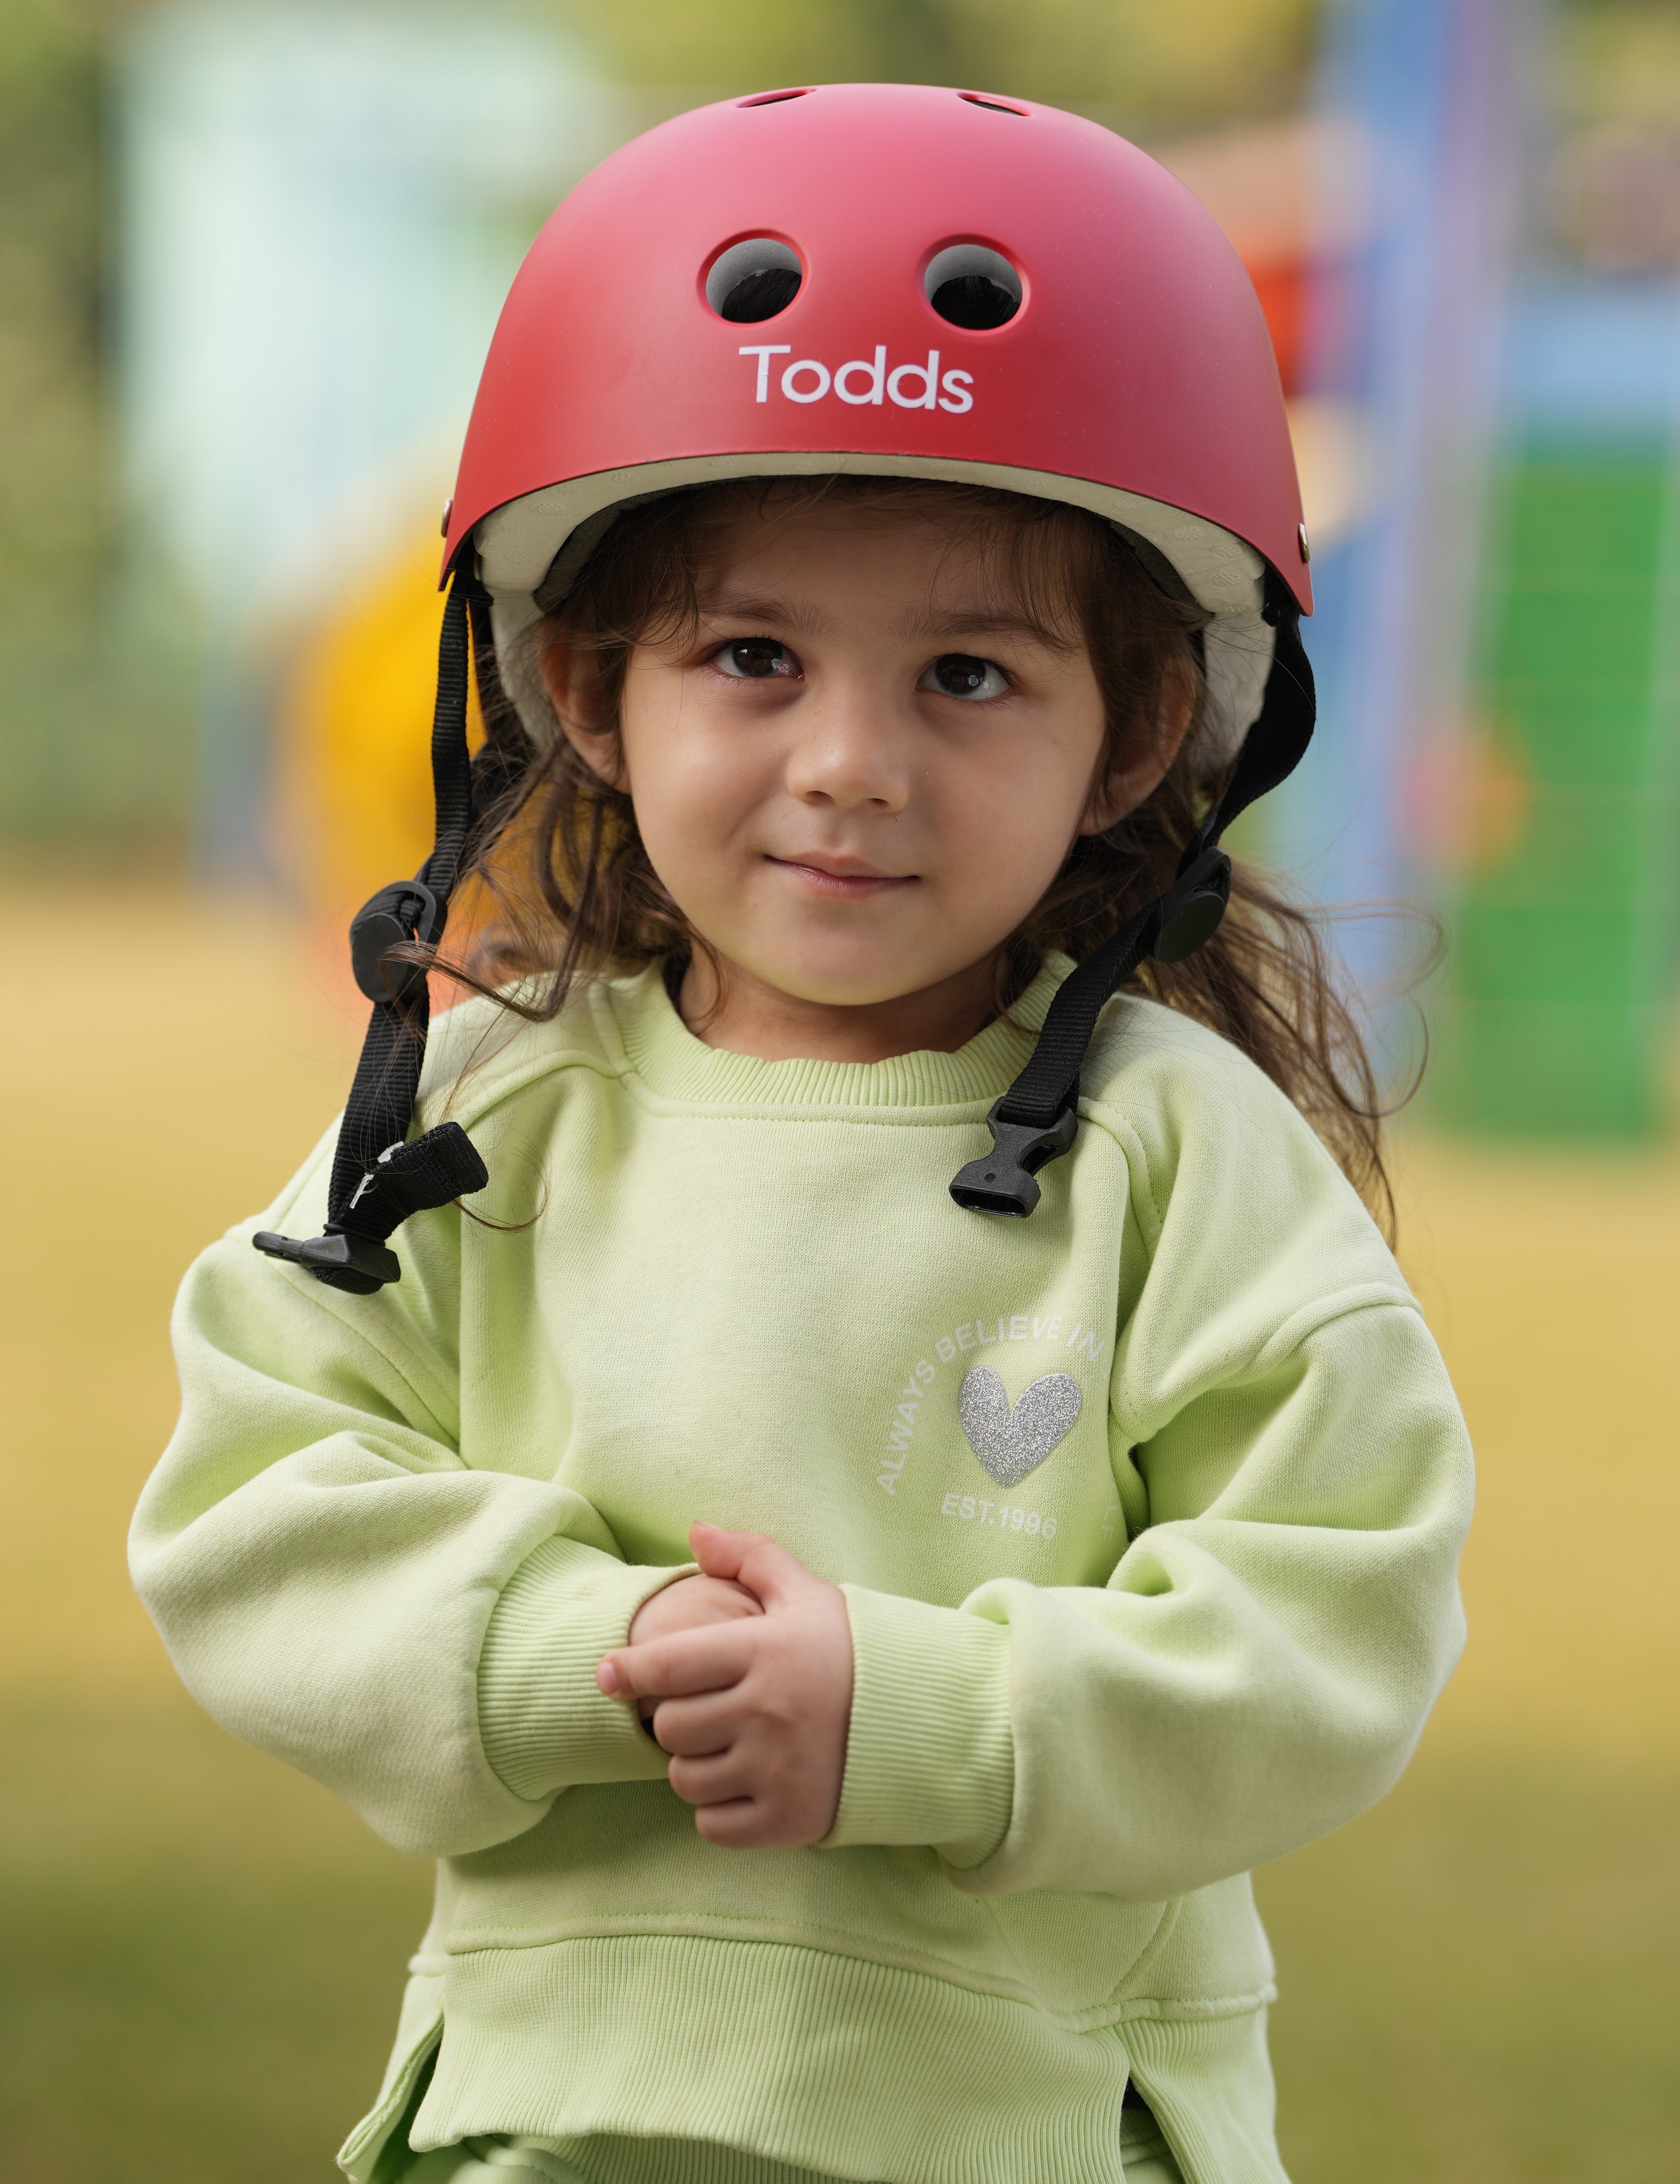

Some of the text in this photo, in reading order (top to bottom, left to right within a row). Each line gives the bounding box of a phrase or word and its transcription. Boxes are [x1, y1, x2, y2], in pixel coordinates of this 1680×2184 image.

[738, 345, 974, 414] Todds
[876, 1316, 1105, 1495] ALWAYS BELIEVE IN
